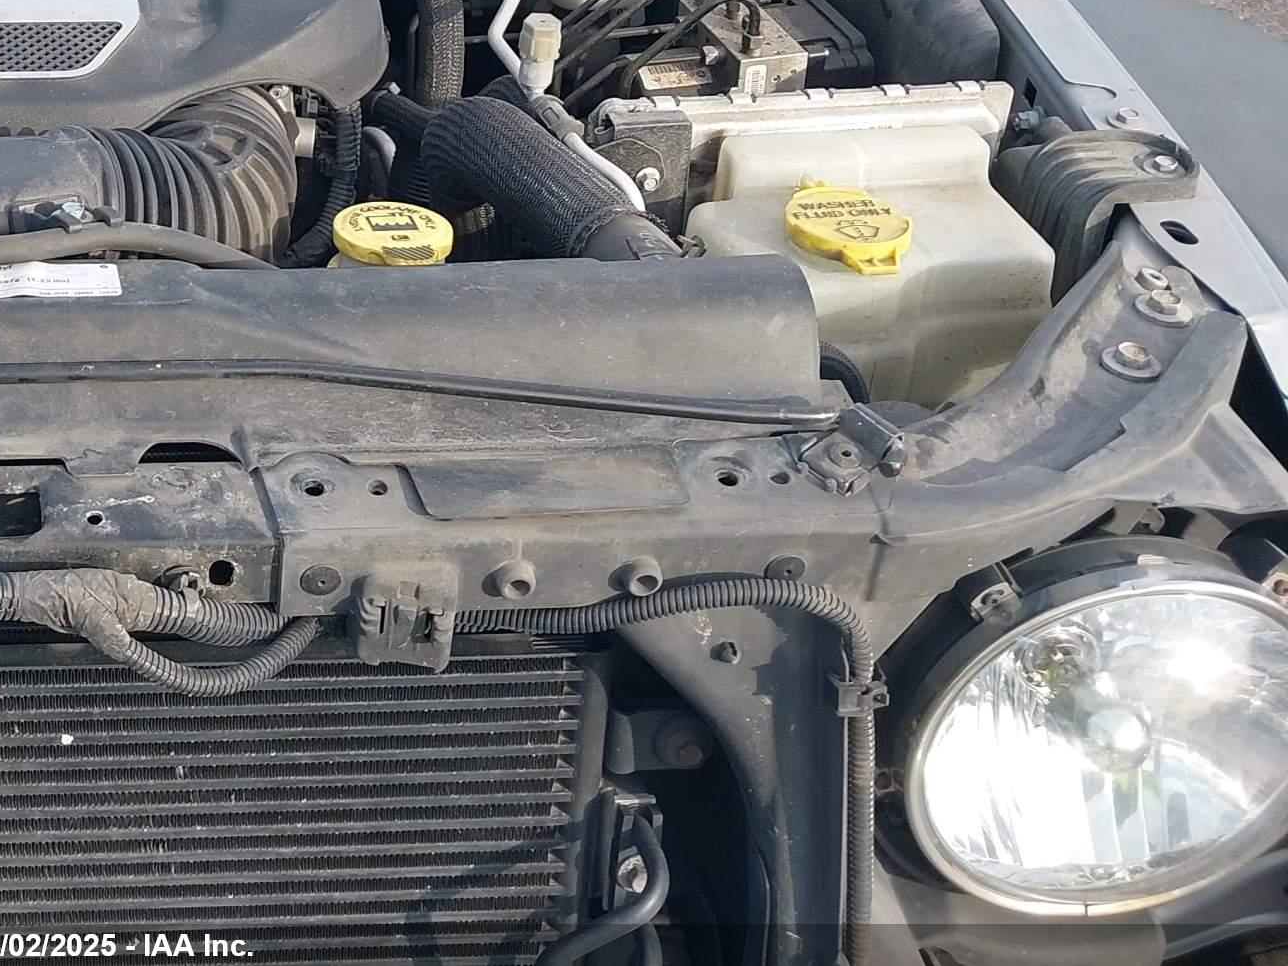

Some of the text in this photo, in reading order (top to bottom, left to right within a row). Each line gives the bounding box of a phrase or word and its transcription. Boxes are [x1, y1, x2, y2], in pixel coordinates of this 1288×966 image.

[797, 200, 875, 211] WASHER
[793, 208, 891, 220] FLUID ONLY
